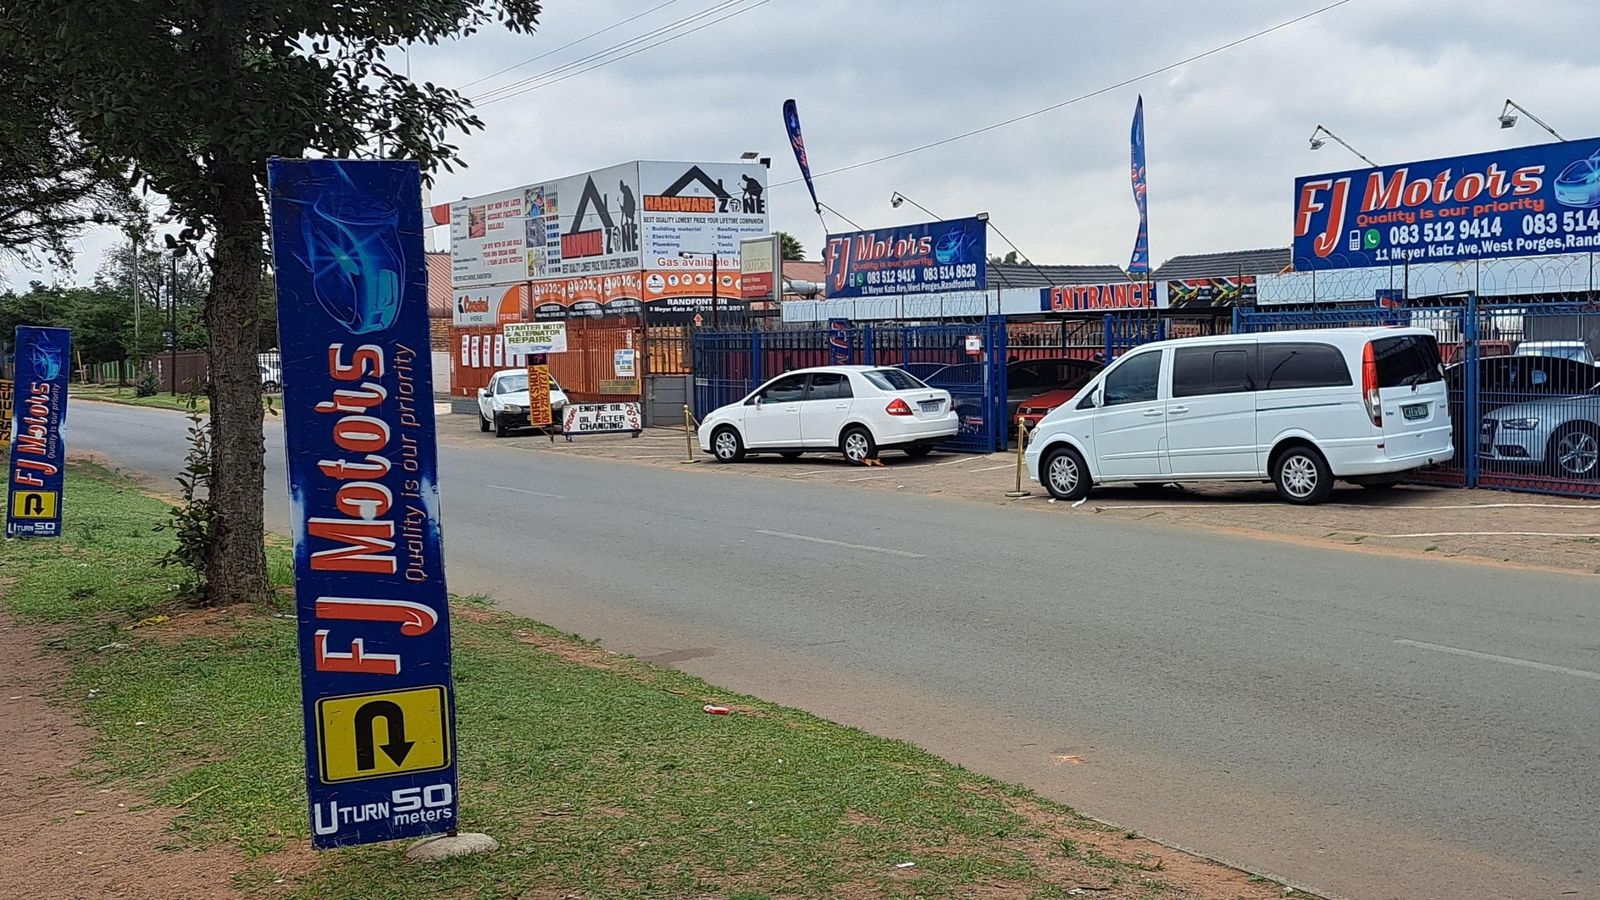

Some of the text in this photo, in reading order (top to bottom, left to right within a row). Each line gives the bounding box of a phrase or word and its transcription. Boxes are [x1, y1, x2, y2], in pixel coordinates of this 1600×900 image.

[644, 196, 766, 214] HARDWARE ZONE
[1294, 162, 1546, 258] FJ Motors
[1356, 198, 1545, 227] Quality is our priority
[1389, 217, 1502, 245] 083 512 9414
[1522, 209, 1600, 235] 083 514
[605, 224, 639, 254] ZONE
[657, 257, 679, 267] Gas
[826, 233, 931, 291] FJ Motors
[853, 262, 879, 271] Quality
[903, 257, 933, 268] priority
[1375, 248, 1389, 261] 11
[1391, 247, 1425, 261] Meyer
[1428, 244, 1454, 257] Katz
[867, 268, 916, 285] 083 512 9414
[923, 263, 977, 281] 083 514 8628
[1050, 282, 1155, 312] ENTRANCE
[505, 324, 541, 332] STARTER
[508, 336, 552, 344] REPAIRS
[529, 366, 541, 424] WORKSHOP
[15, 382, 57, 486] FJ Motors
[580, 422, 624, 430] CHANGING
[393, 343, 428, 582] Quality is our priority
[308, 343, 438, 675] FJ Motors
[34, 522, 55, 530] 50
[392, 784, 452, 812] 50
[394, 808, 452, 825] meters
